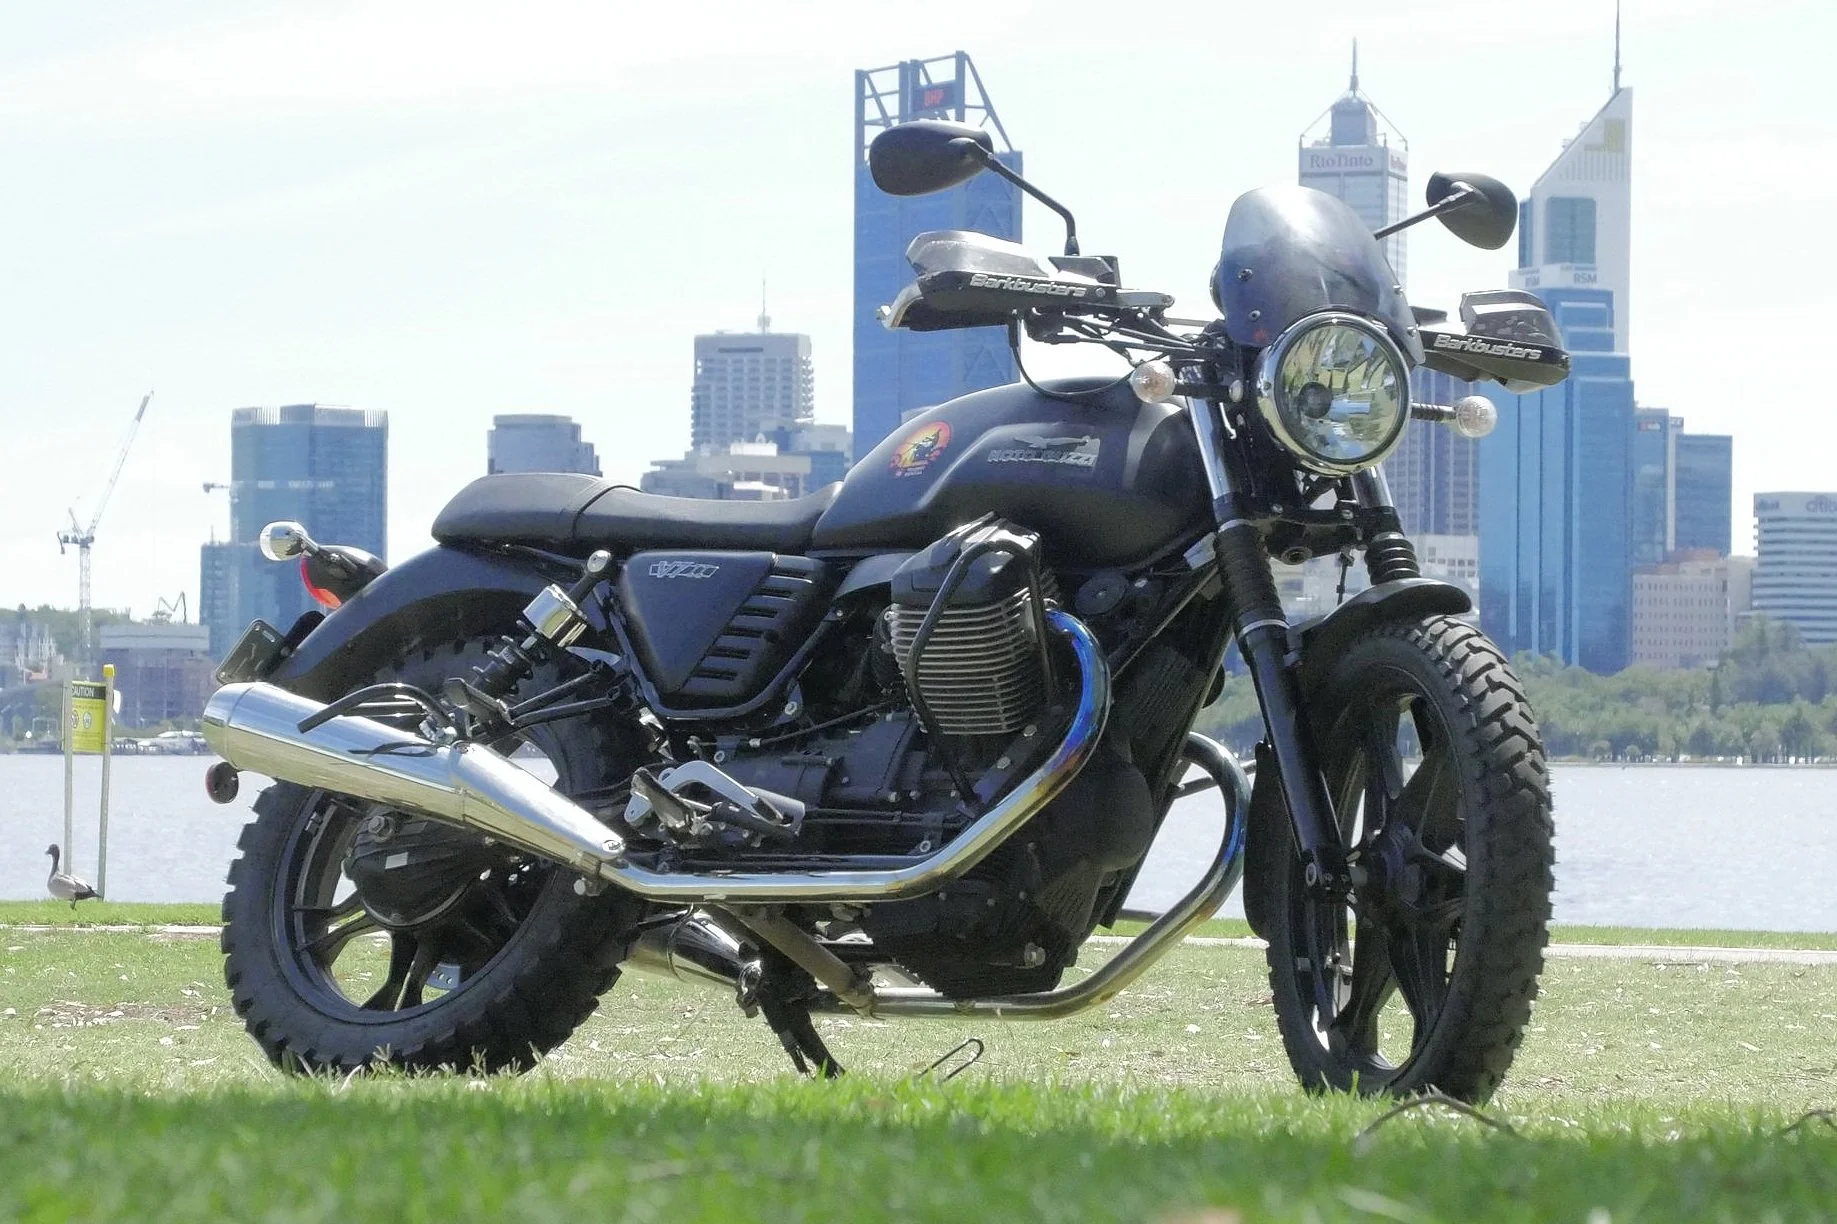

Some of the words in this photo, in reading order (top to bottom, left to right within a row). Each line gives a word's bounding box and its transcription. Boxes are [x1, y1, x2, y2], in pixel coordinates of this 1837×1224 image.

[970, 273, 1087, 297] Barkbusters
[1573, 272, 1598, 284] RSM
[1433, 333, 1542, 360] Barkbusters
